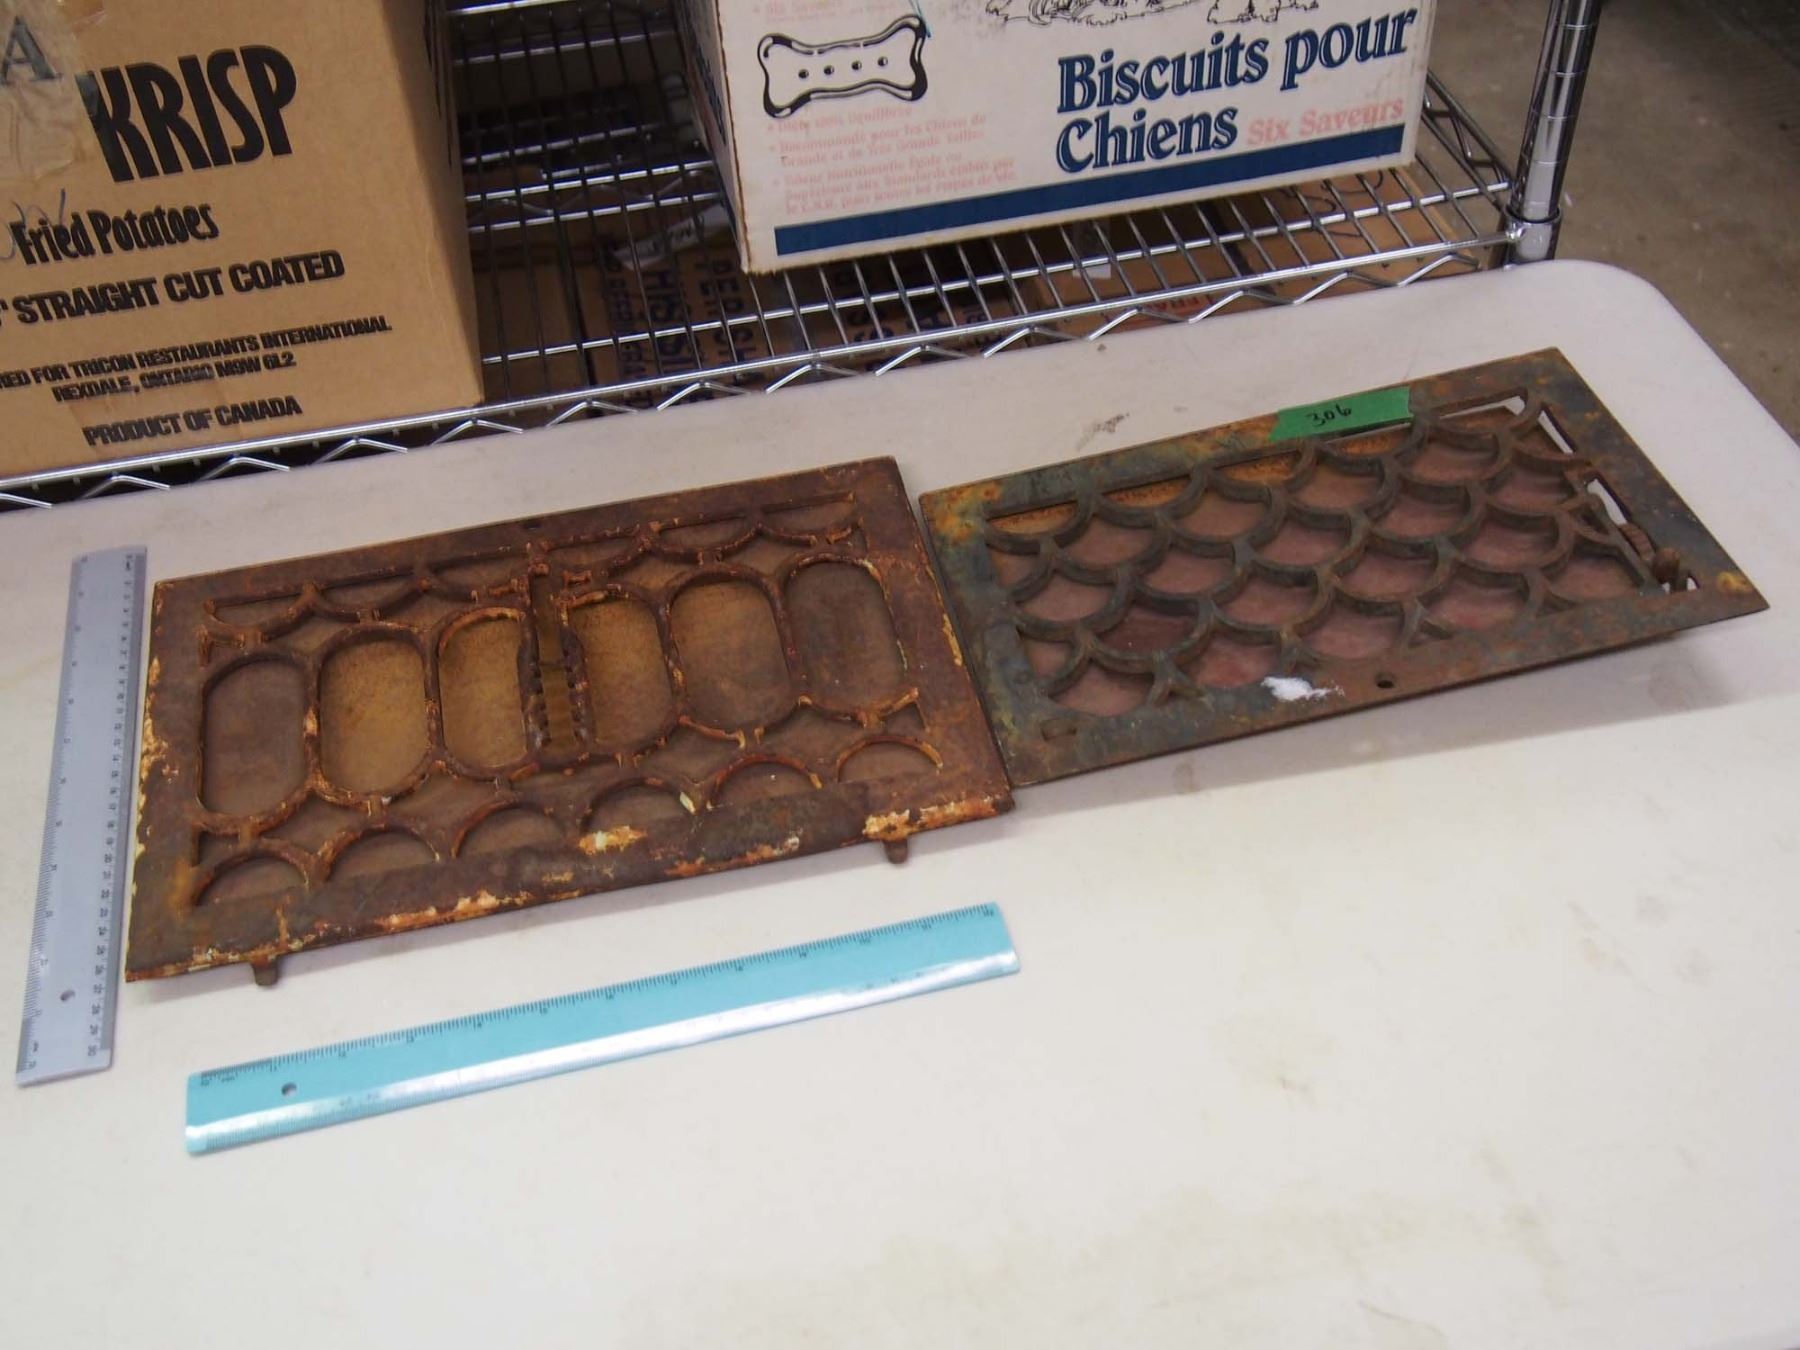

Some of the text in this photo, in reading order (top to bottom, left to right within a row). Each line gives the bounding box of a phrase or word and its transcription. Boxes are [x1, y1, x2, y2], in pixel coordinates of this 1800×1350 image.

[0, 15, 62, 86] A
[1057, 8, 1419, 113] Biscuits pour
[74, 44, 297, 183] KRISP
[1056, 106, 1239, 174] Chiens
[1246, 99, 1405, 146] Six Saveurs
[10, 212, 97, 264] Fried
[87, 203, 220, 254] Potatoes
[13, 276, 160, 324] STRAIGHT
[163, 267, 225, 301] CUT
[228, 250, 346, 293] COATED
[30, 364, 71, 384] FOR
[68, 353, 137, 378] TRICON
[135, 334, 261, 369] RESTAURANTS
[260, 315, 392, 349] INTERNATIONAL
[82, 395, 303, 446] PRODUCT OF CANADA
[1306, 404, 1352, 427] 306
